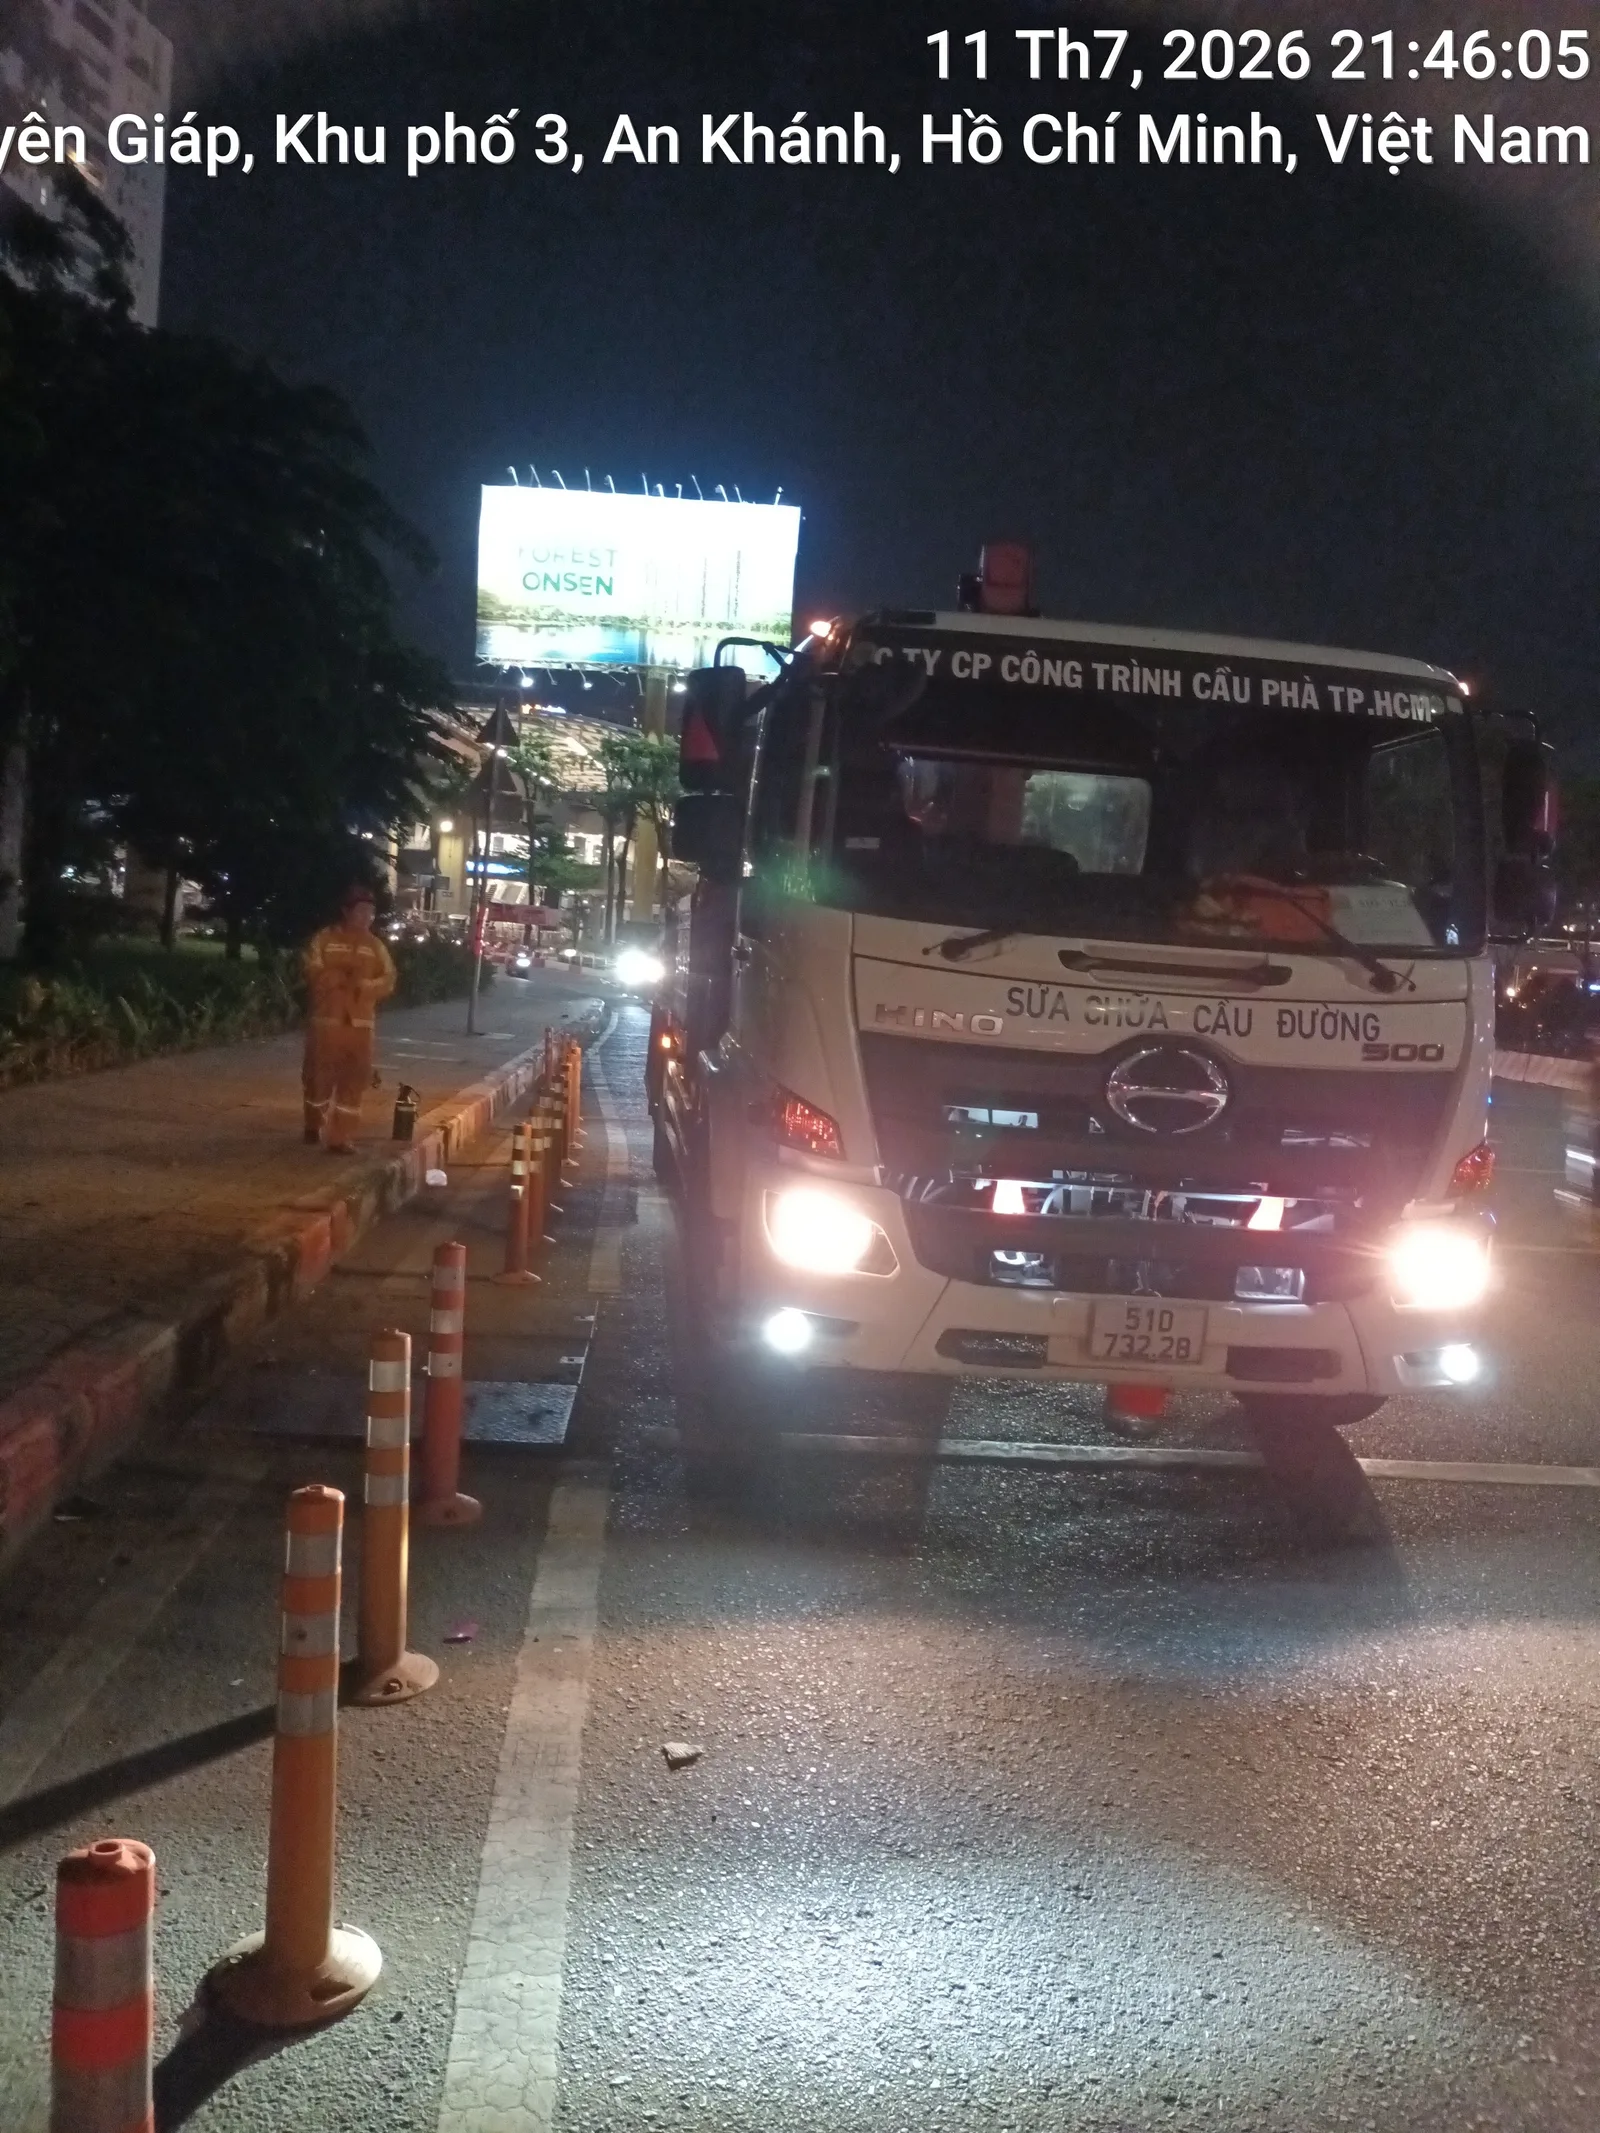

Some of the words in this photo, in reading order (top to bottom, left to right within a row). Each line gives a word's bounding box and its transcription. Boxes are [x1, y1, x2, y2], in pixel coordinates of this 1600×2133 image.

[518, 545, 618, 568] OREST
[522, 571, 614, 596] ONSEN
[951, 650, 993, 680] CP
[1000, 649, 1083, 689] CÔNG
[1091, 658, 1182, 698] TRÌNH
[1192, 665, 1251, 704] CẦU
[1261, 675, 1320, 711] PHÀ
[1327, 685, 1432, 723] TP.HCM
[875, 1003, 1004, 1037] HINO
[1005, 984, 1070, 1022] SỬA
[1083, 991, 1170, 1030] CHỮA
[1192, 998, 1253, 1038] CẦU
[1276, 1001, 1381, 1042] ĐƯỜNG
[1360, 1043, 1445, 1063] 500
[1124, 1307, 1174, 1333] 51D
[1103, 1332, 1191, 1360] 732.28
